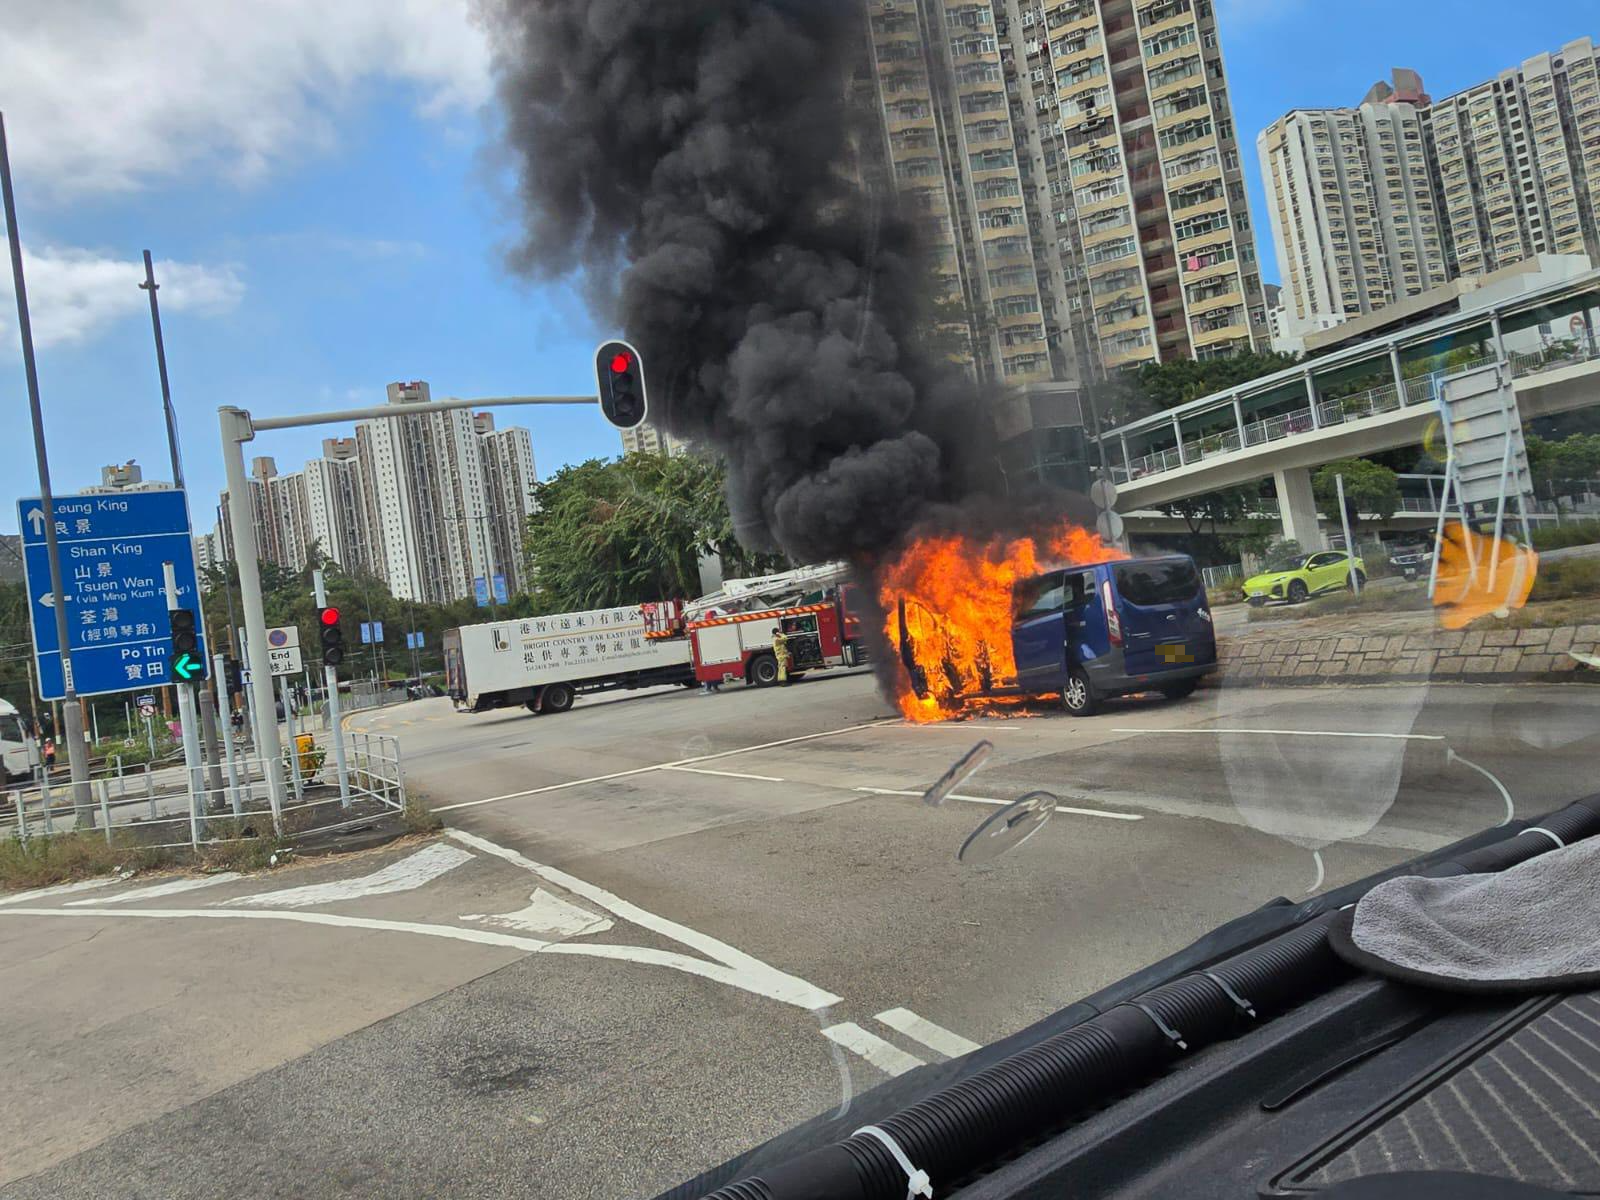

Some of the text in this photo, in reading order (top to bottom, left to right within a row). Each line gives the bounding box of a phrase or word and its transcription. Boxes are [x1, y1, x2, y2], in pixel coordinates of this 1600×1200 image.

[53, 500, 128, 515] eung King
[55, 518, 92, 535] 良景
[70, 543, 143, 558] Shan King
[74, 562, 113, 579] 山景
[75, 577, 154, 593] Tsuen Wan
[103, 592, 127, 602] Ming
[131, 589, 154, 599] Kum
[79, 607, 119, 625] 荃灣
[523, 641, 550, 650] BRIGHT
[552, 636, 585, 646] COUNTRY
[121, 646, 165, 660] Po Tin
[271, 650, 290, 660] End
[124, 661, 164, 681] 寶田
